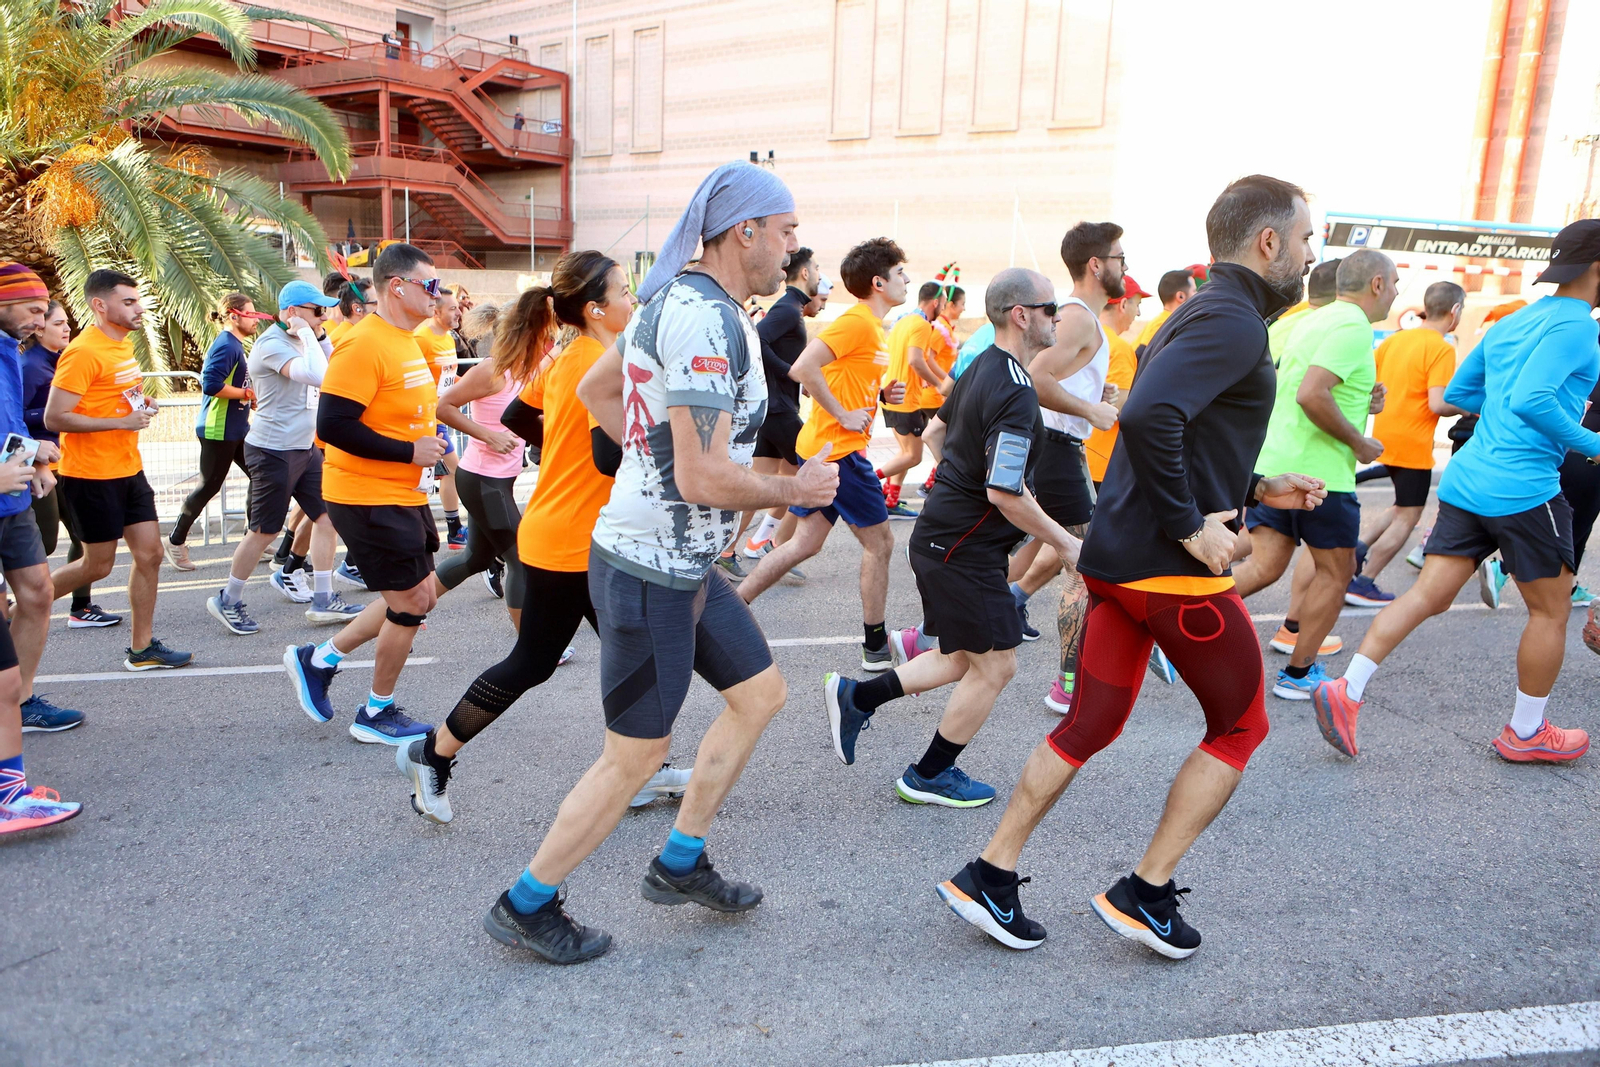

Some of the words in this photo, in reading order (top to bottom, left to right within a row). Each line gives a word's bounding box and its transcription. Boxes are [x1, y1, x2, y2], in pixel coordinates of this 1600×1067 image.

[1351, 227, 1364, 244] P
[1413, 239, 1492, 258] ENTRADA
[693, 358, 727, 373] Arroyo
[373, 722, 398, 736] HOKA
